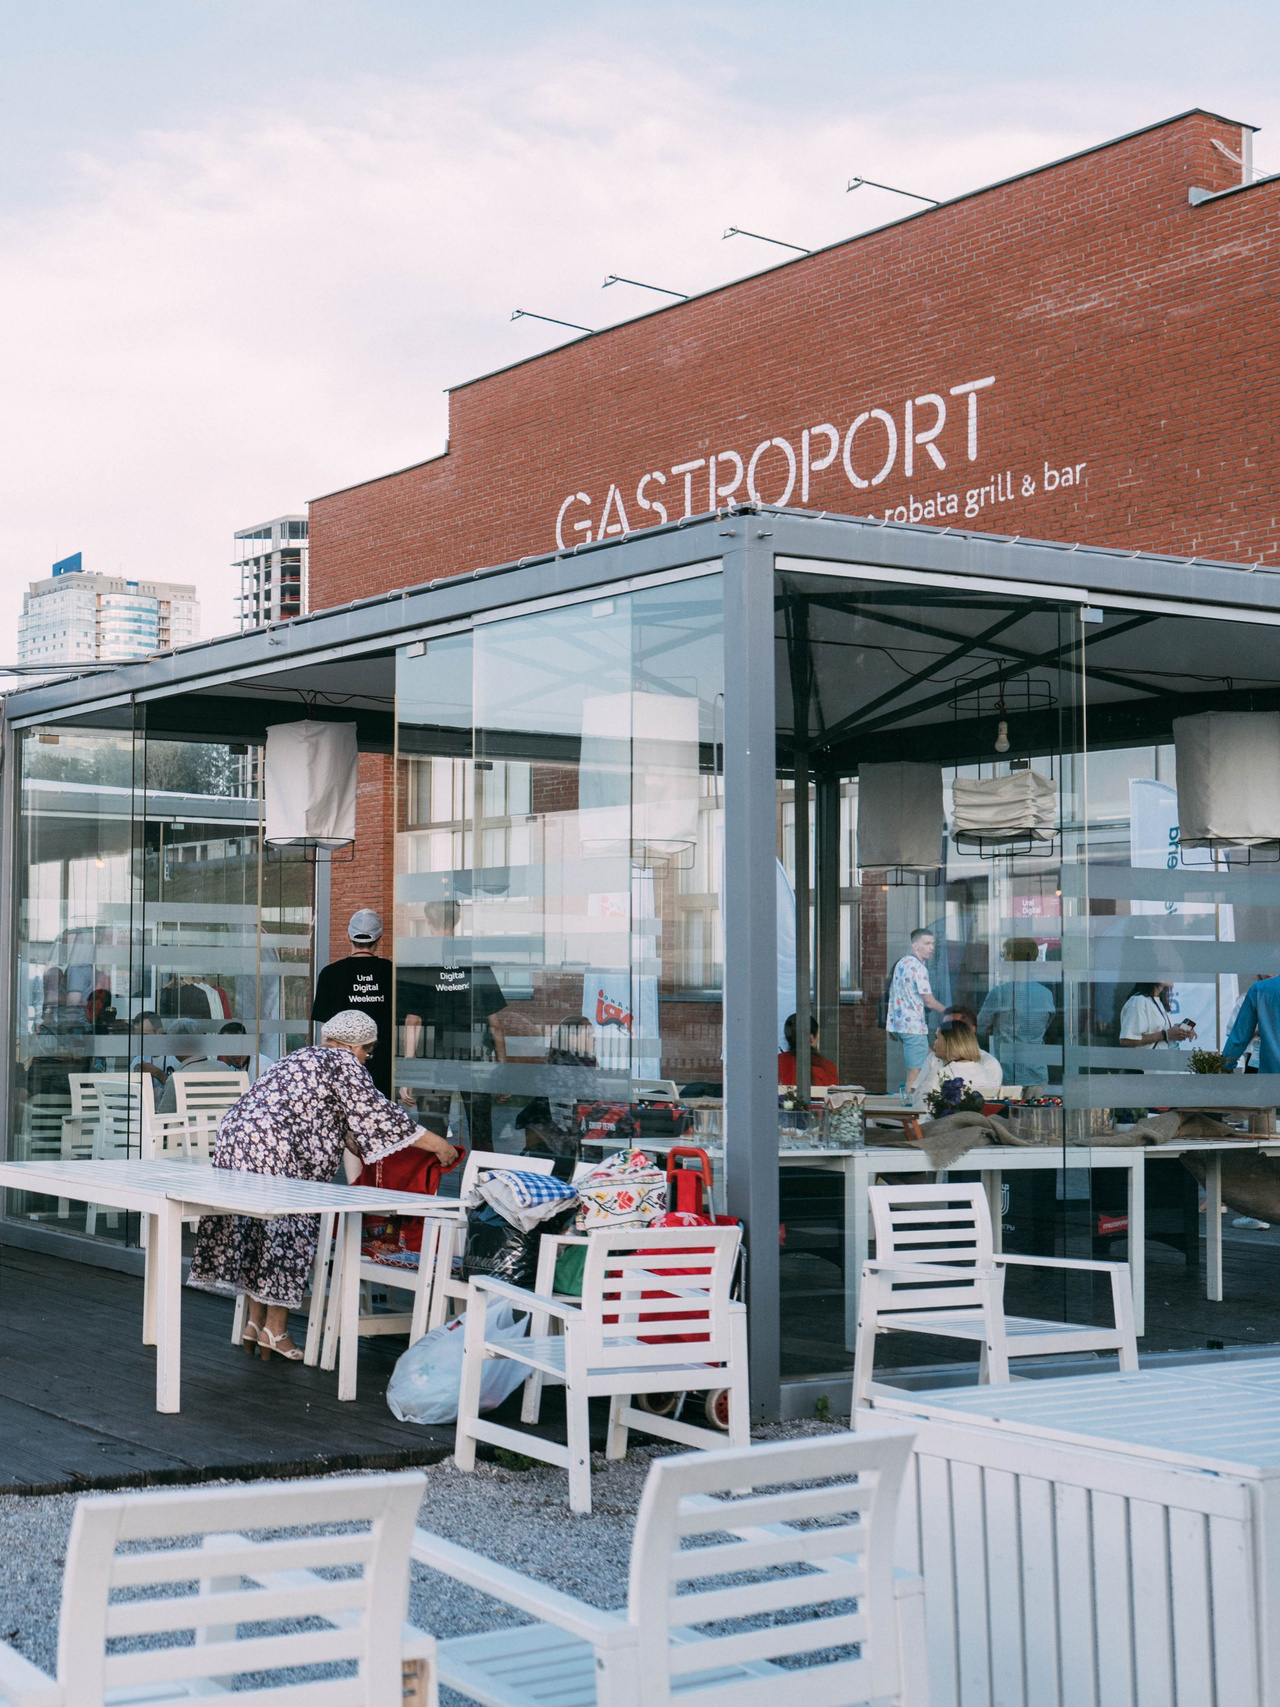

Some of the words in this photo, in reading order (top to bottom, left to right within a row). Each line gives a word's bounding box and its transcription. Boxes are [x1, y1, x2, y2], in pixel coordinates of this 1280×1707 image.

[556, 376, 996, 550] GASTROPORT
[884, 492, 959, 524] robata
[964, 471, 1015, 518] grill
[1021, 474, 1036, 497] &
[1044, 461, 1087, 491] bar
[356, 974, 374, 982] Ural
[440, 970, 465, 982] Digital
[353, 983, 379, 993] Digital
[348, 995, 385, 1003] Weekend
